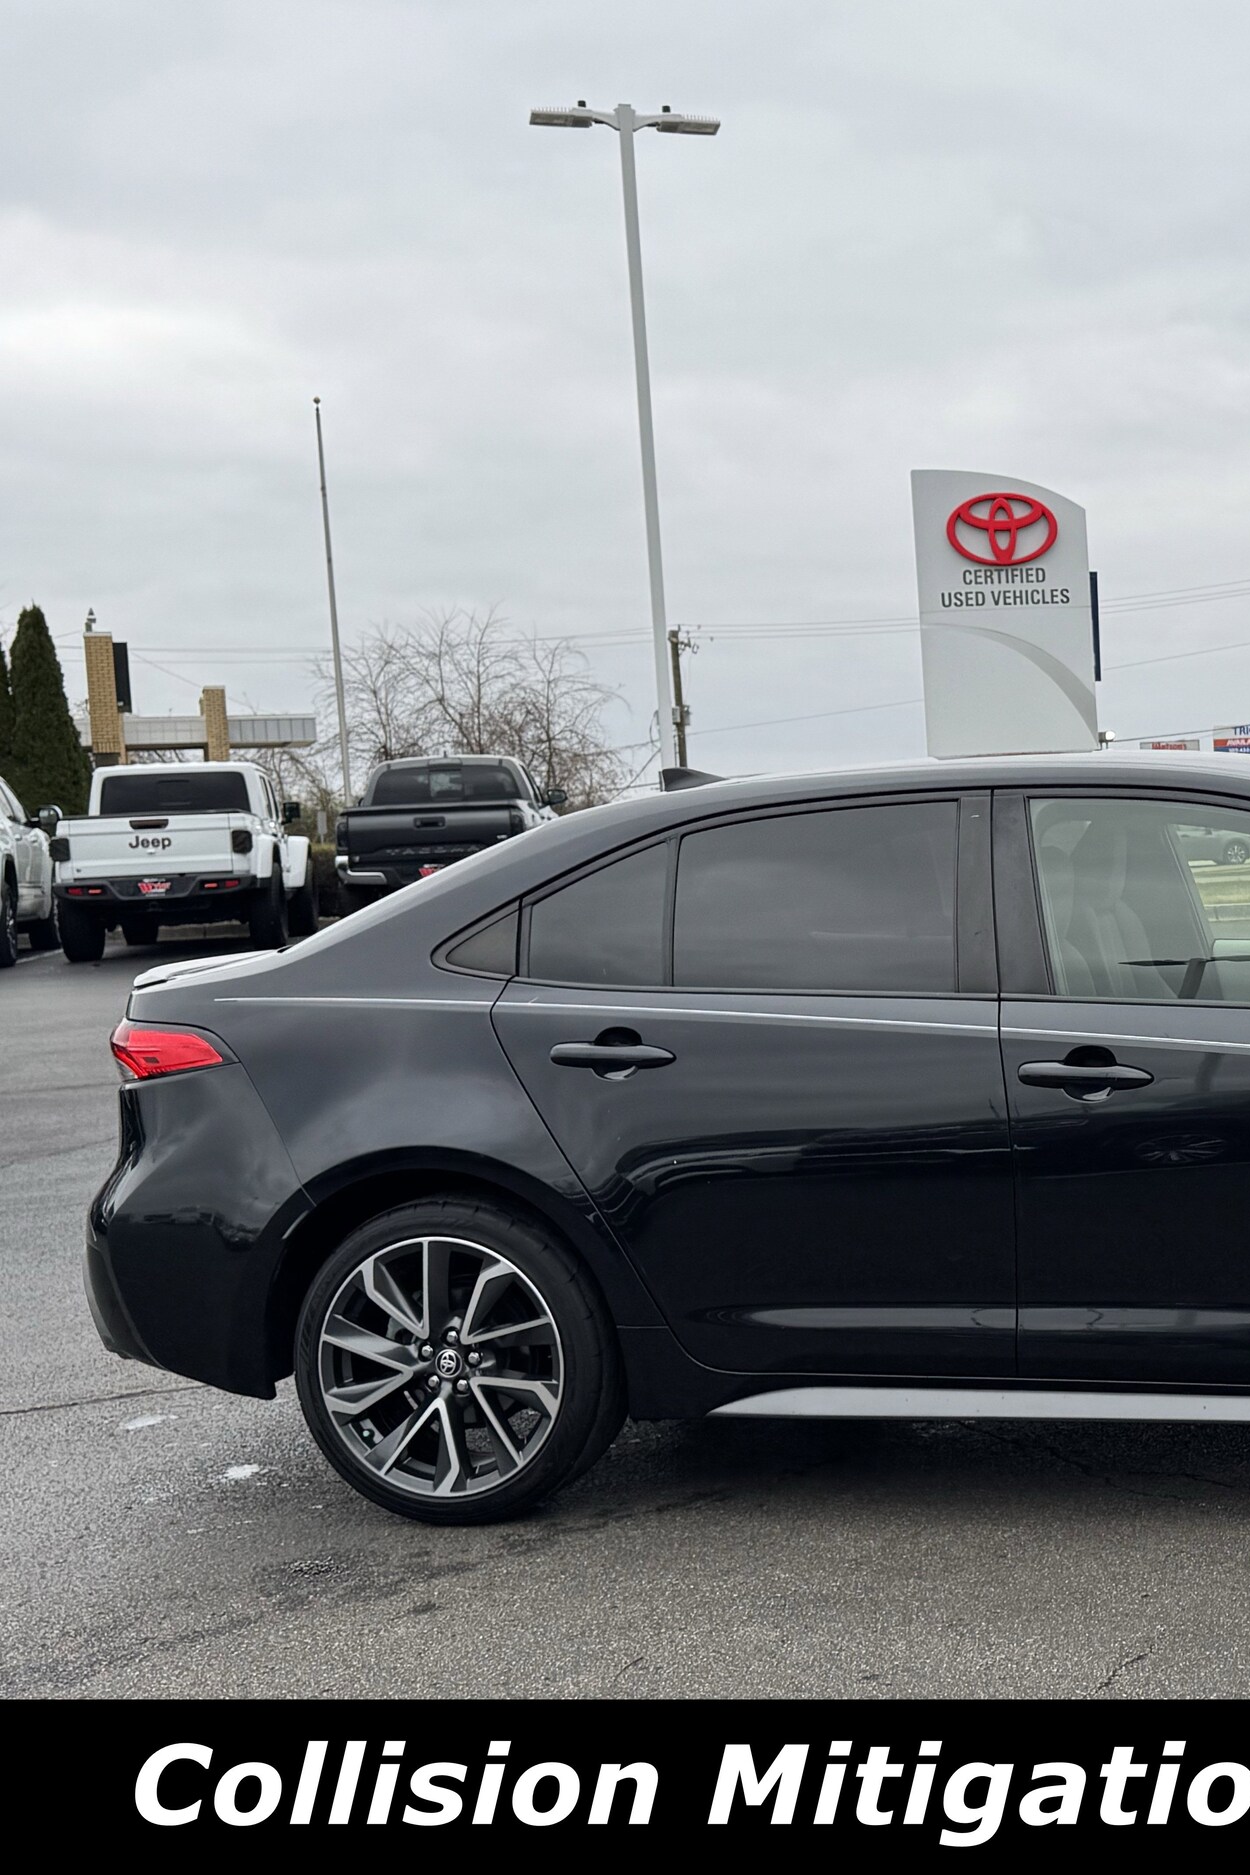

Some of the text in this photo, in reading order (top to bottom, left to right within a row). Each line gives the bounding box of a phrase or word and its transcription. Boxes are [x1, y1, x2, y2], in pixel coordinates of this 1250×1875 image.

[962, 568, 1046, 585] CERTIFIED
[941, 588, 1070, 608] USED VEHICLES
[128, 835, 171, 850] Jeep
